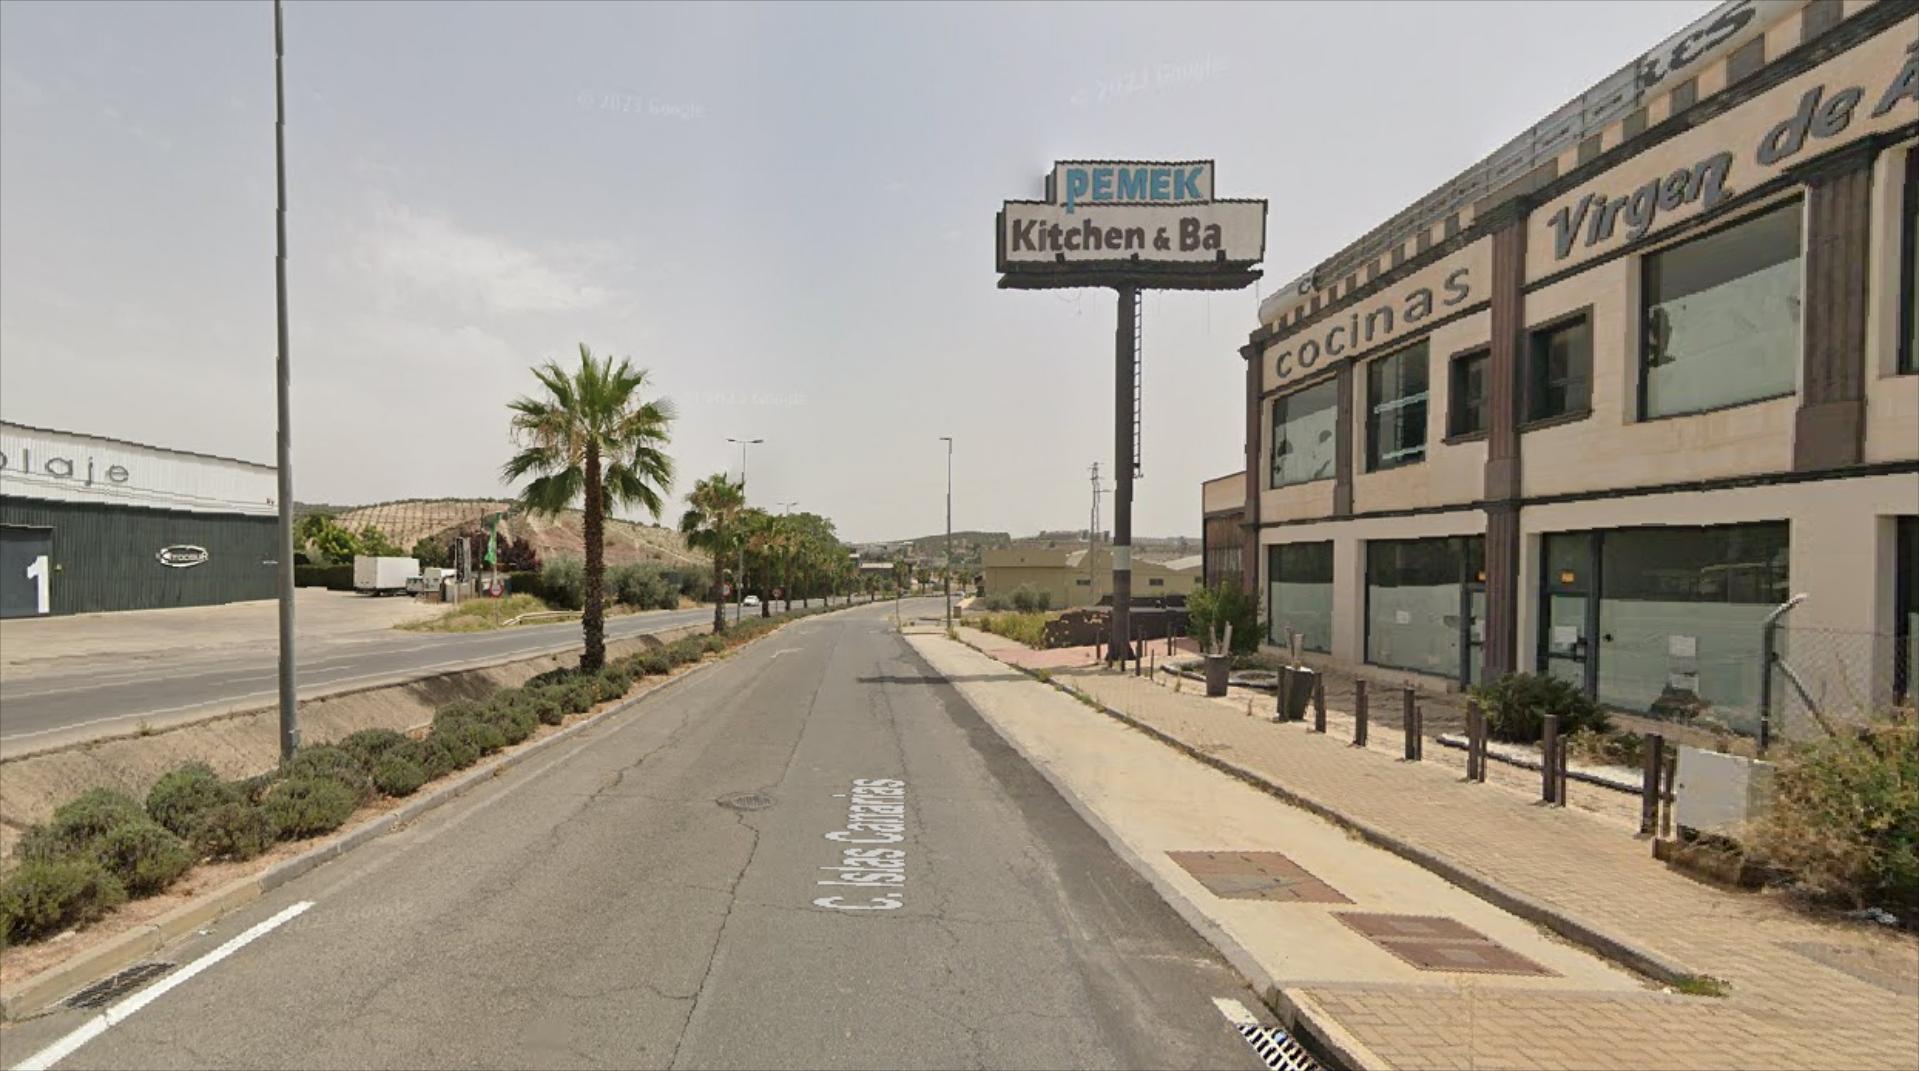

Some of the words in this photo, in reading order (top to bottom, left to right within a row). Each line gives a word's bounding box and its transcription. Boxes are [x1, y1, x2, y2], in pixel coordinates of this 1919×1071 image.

[1066, 166, 1204, 214] PEMEK
[1548, 152, 1735, 260] Virgen
[1757, 84, 1865, 166] de
[1012, 218, 1145, 251] Kitchen
[1153, 227, 1171, 251] &
[1180, 217, 1222, 251] Ba
[1276, 267, 1470, 378] cocinas
[27, 555, 49, 613] 1
